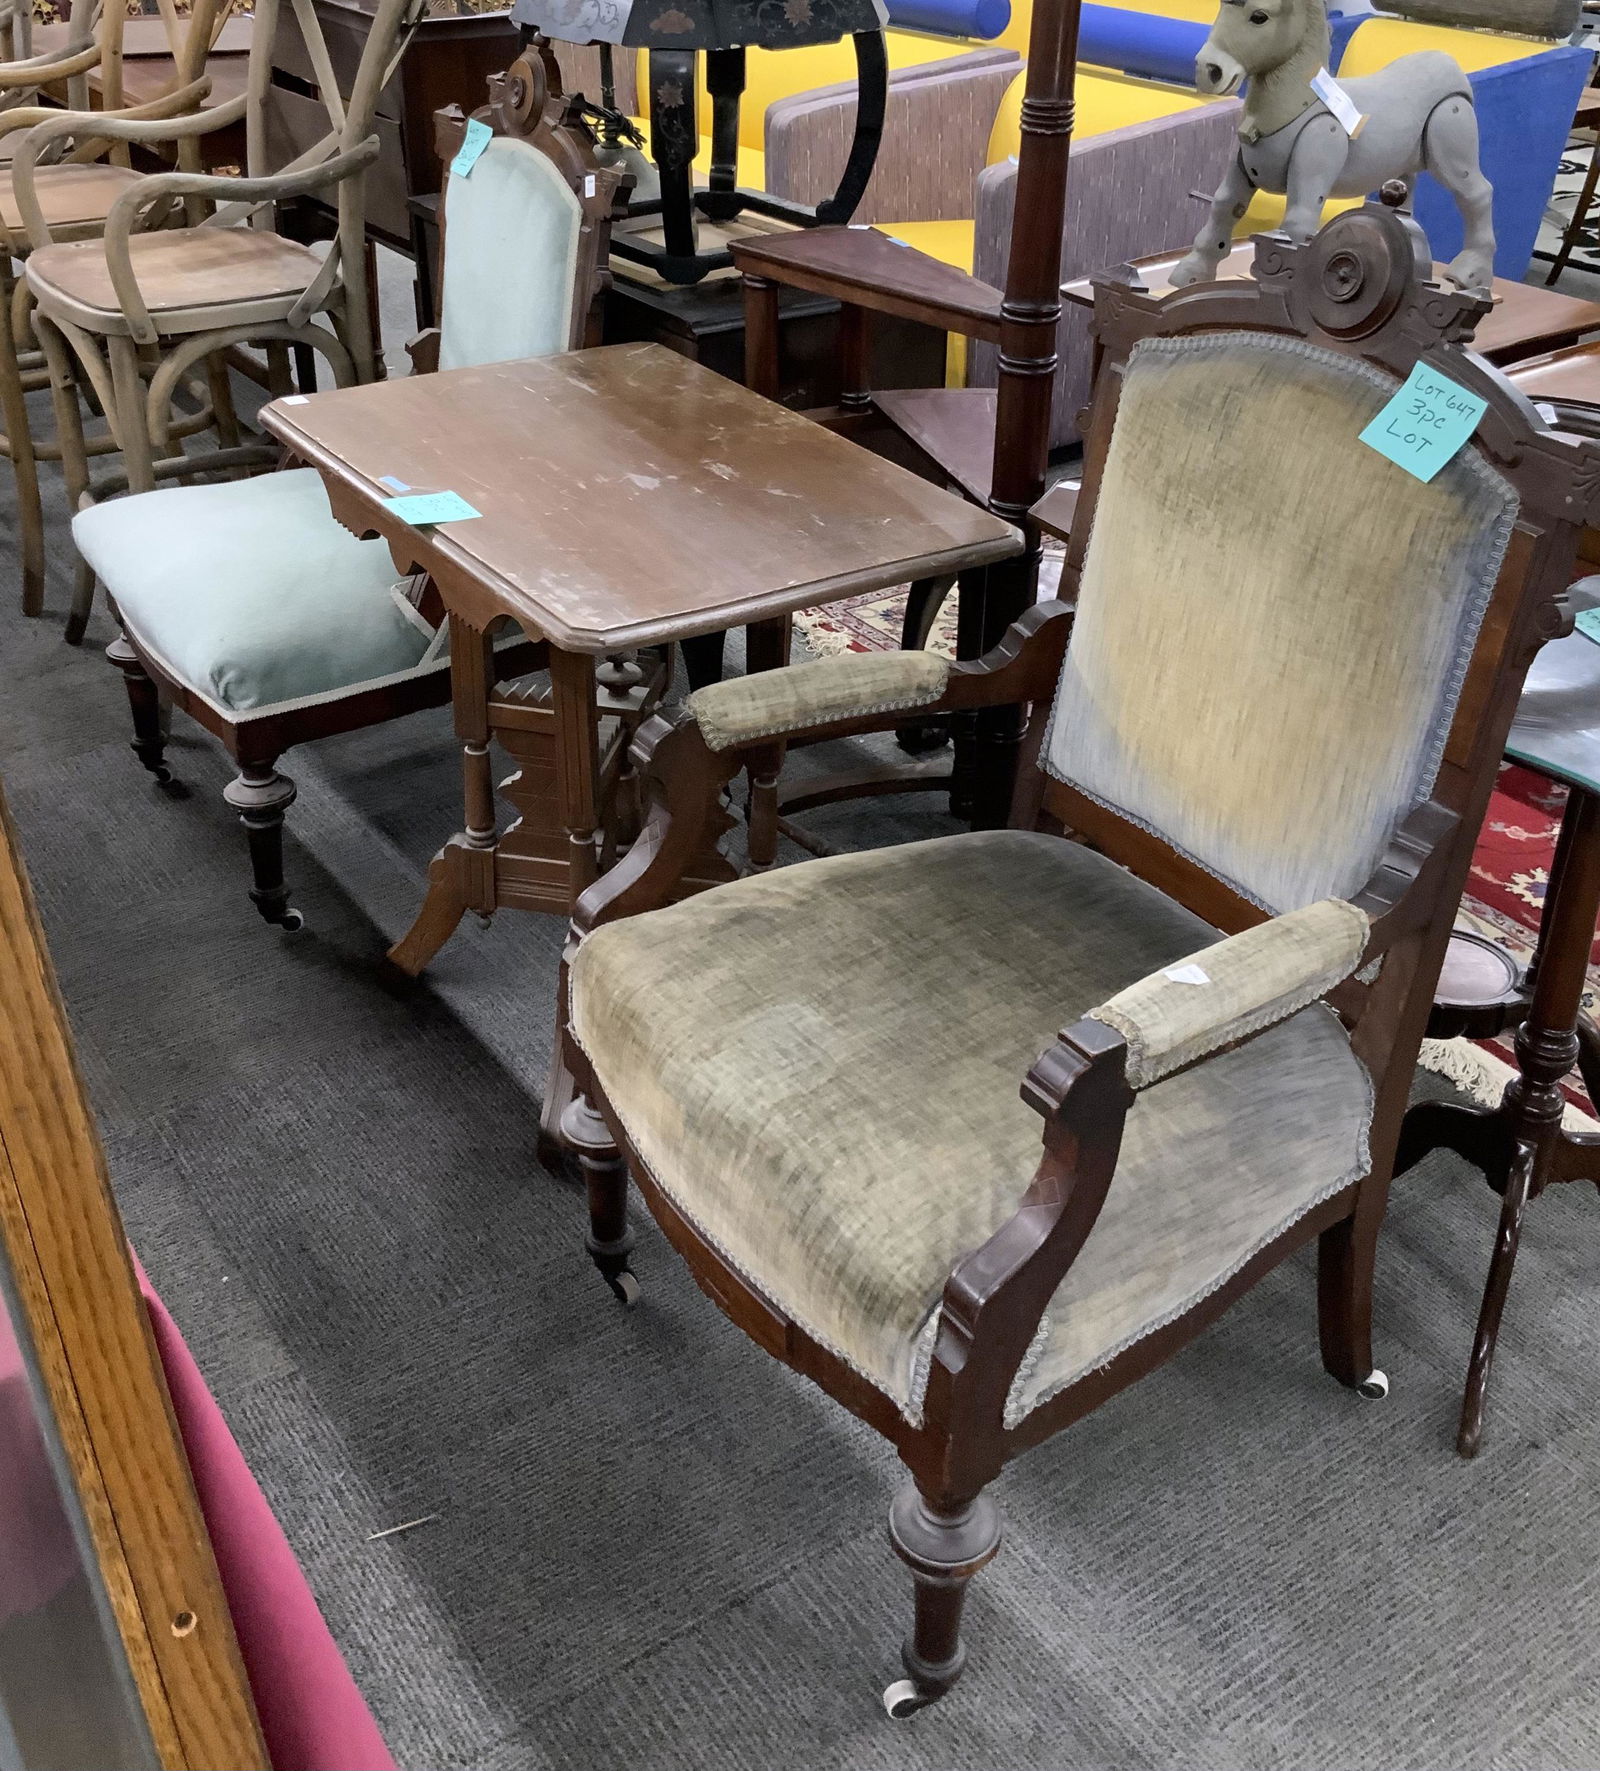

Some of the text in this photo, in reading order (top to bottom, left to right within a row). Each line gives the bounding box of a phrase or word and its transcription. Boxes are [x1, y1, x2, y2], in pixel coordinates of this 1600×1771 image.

[1414, 374, 1476, 422] LOT 647
[1386, 418, 1432, 453] LOT
